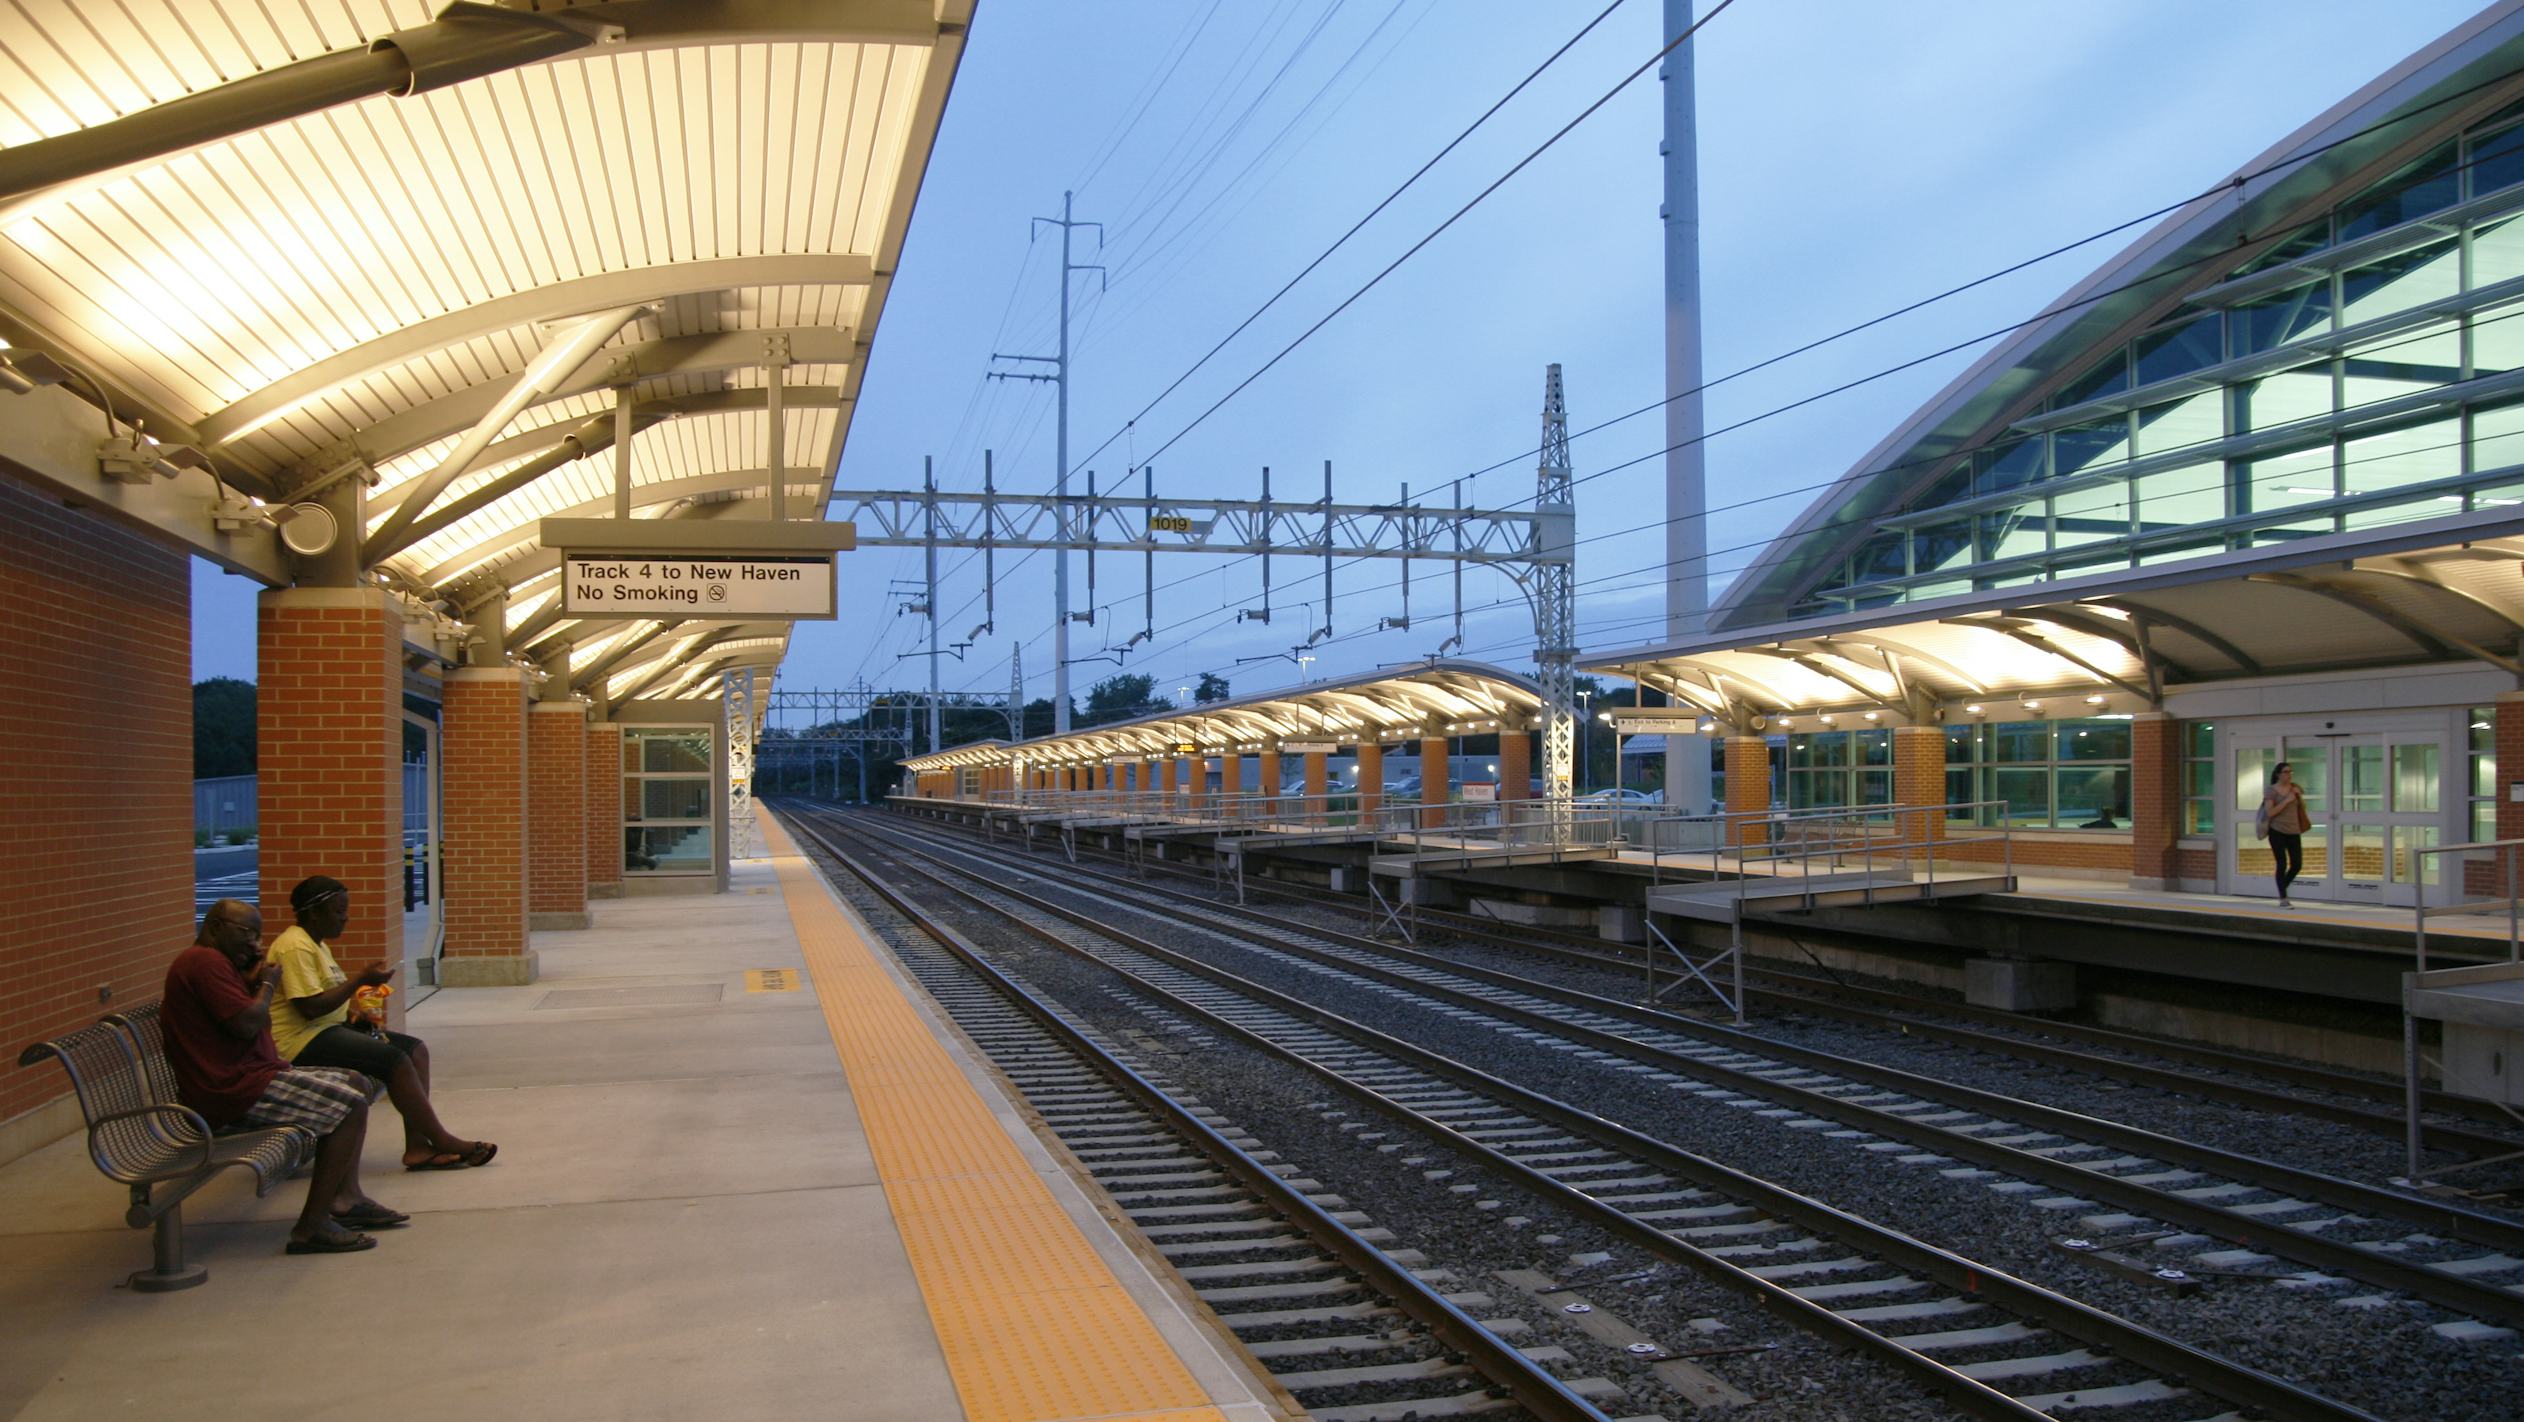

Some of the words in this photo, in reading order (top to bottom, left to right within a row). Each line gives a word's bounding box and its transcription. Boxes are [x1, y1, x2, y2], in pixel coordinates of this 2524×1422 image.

[1154, 518, 1187, 531] 1019
[577, 563, 630, 579] Track
[640, 564, 652, 579] 4
[662, 565, 681, 579] to
[691, 565, 733, 580] New
[742, 565, 800, 580] Haven
[577, 585, 603, 600] No
[613, 585, 698, 604] Smoking
